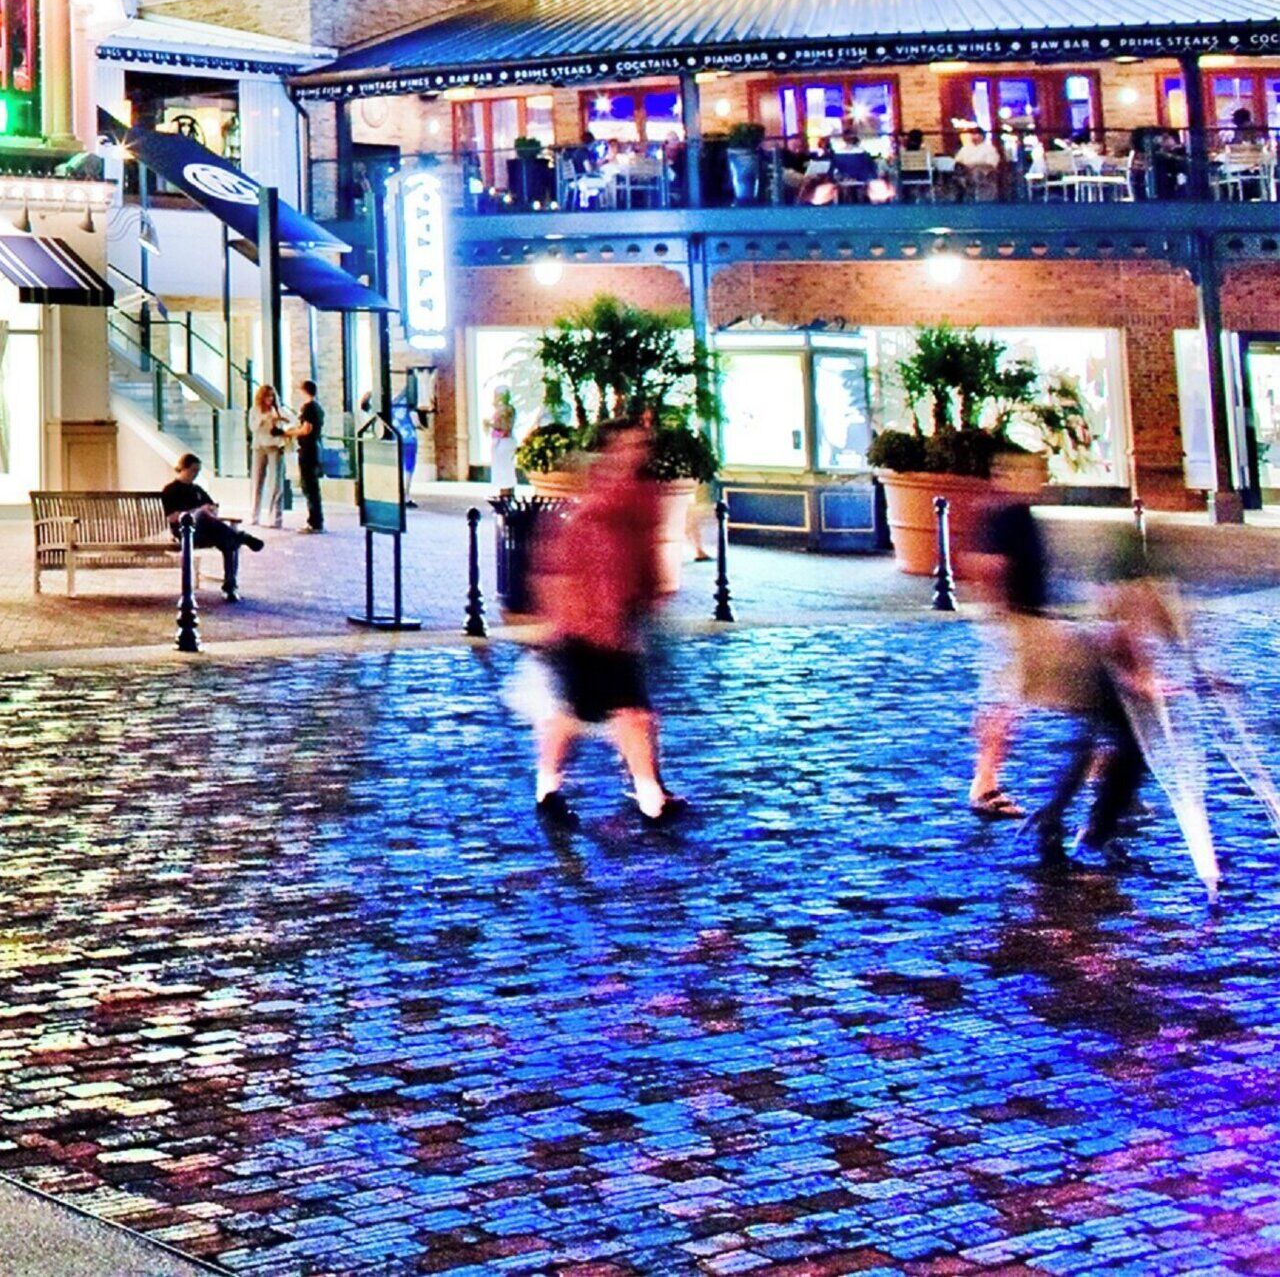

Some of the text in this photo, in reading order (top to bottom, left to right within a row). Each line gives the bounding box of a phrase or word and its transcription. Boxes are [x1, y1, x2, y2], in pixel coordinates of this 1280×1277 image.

[359, 81, 398, 92] VINTAGE
[400, 77, 429, 88] WINES
[448, 73, 471, 84] RAW
[473, 72, 493, 82] BAR
[514, 68, 548, 80] PRIME
[551, 64, 592, 78] STEAKS
[615, 59, 680, 72] COCKTAILS
[704, 53, 741, 65] PIANO
[745, 51, 769, 64] BAR
[795, 47, 834, 59] PRIME
[838, 46, 868, 58] FISH
[895, 42, 953, 55] VINTAGE
[958, 41, 1002, 53] WINES
[1031, 39, 1058, 51] RAW
[1063, 38, 1090, 50] BAR
[1120, 36, 1162, 48] PRIME
[1168, 35, 1220, 47] STEAKS
[1250, 33, 1280, 45] COC
